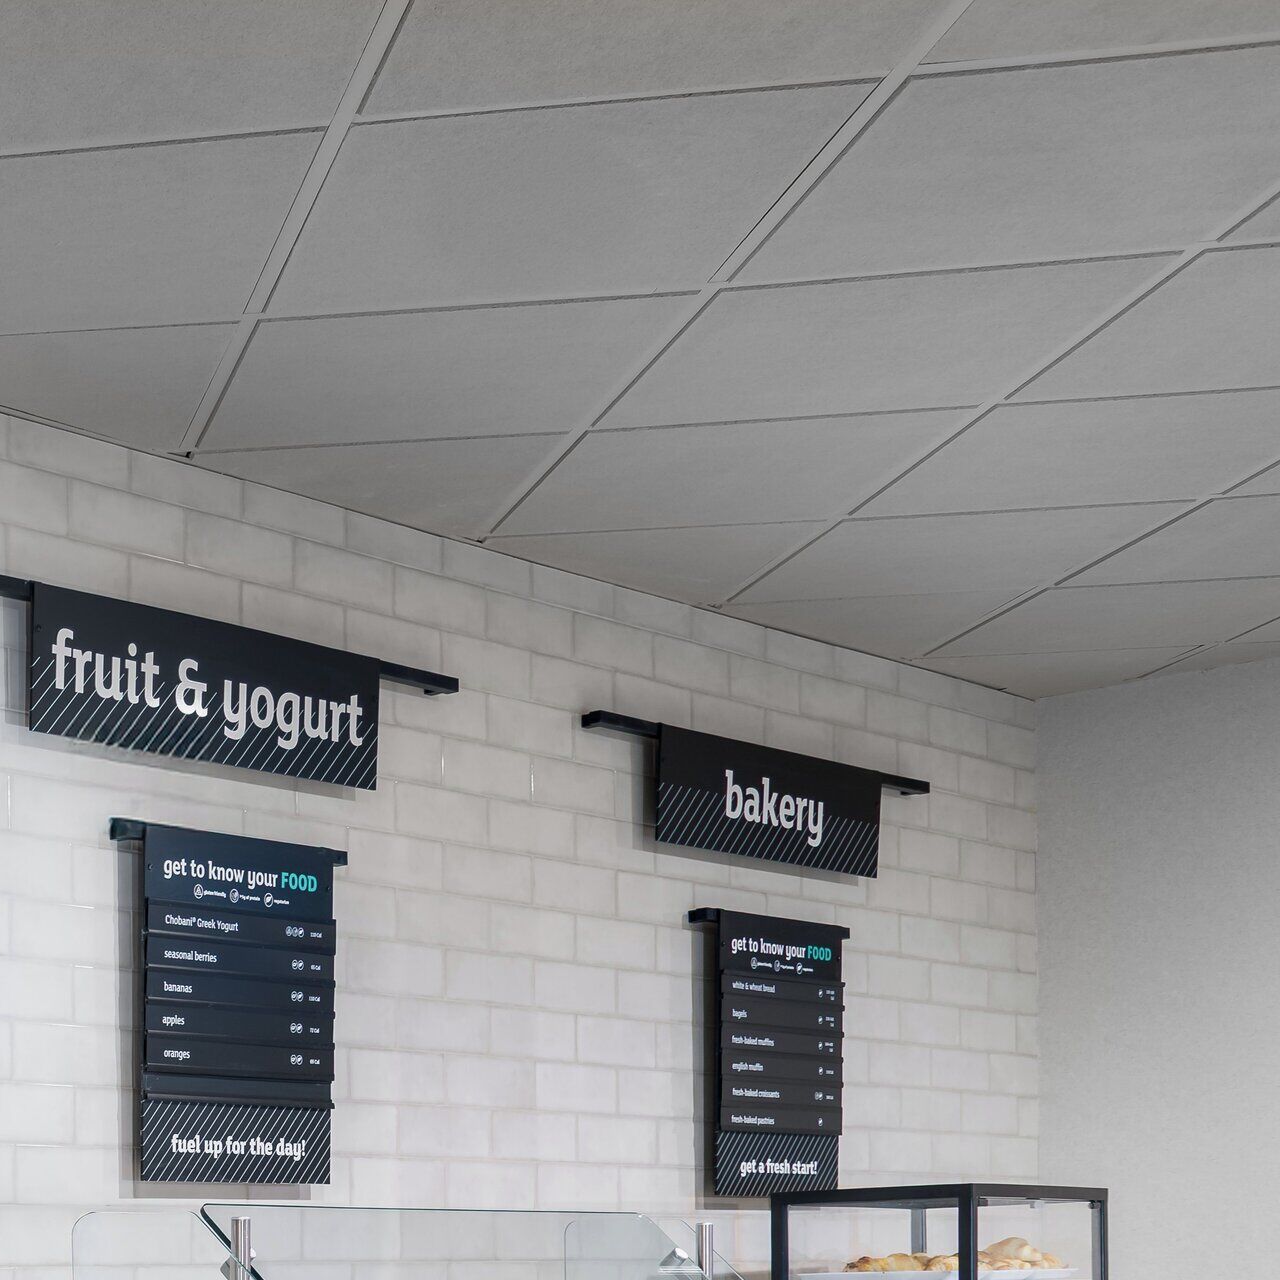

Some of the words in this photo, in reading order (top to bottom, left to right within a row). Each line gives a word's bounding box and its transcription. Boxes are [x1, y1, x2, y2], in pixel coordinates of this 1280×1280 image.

[51, 627, 161, 709] fruit
[174, 657, 209, 719] &
[222, 678, 364, 751] yogurt
[724, 768, 825, 848] bakery
[163, 858, 187, 879] get
[190, 859, 206, 879] to
[207, 860, 245, 884] know
[247, 870, 279, 890] your
[281, 871, 318, 893] FOOD
[197, 918, 216, 930] Greek
[216, 920, 239, 932] Yogurt
[163, 949, 193, 961] seasonal
[194, 950, 218, 963] berries
[731, 936, 747, 955] get
[748, 937, 759, 953] to
[759, 937, 785, 956] know
[785, 945, 807, 961] your
[807, 945, 832, 962] FOOD
[163, 980, 193, 994] bananas
[161, 1015, 185, 1027] apples
[163, 1049, 191, 1061] oranges
[171, 1133, 201, 1154] fuel
[204, 1139, 224, 1159] up
[225, 1135, 247, 1155] for
[249, 1136, 273, 1156] the
[275, 1137, 306, 1162] day!
[740, 1159, 757, 1177] get
[758, 1164, 765, 1174] a
[765, 1158, 791, 1174] fresh
[791, 1160, 818, 1175] start!
